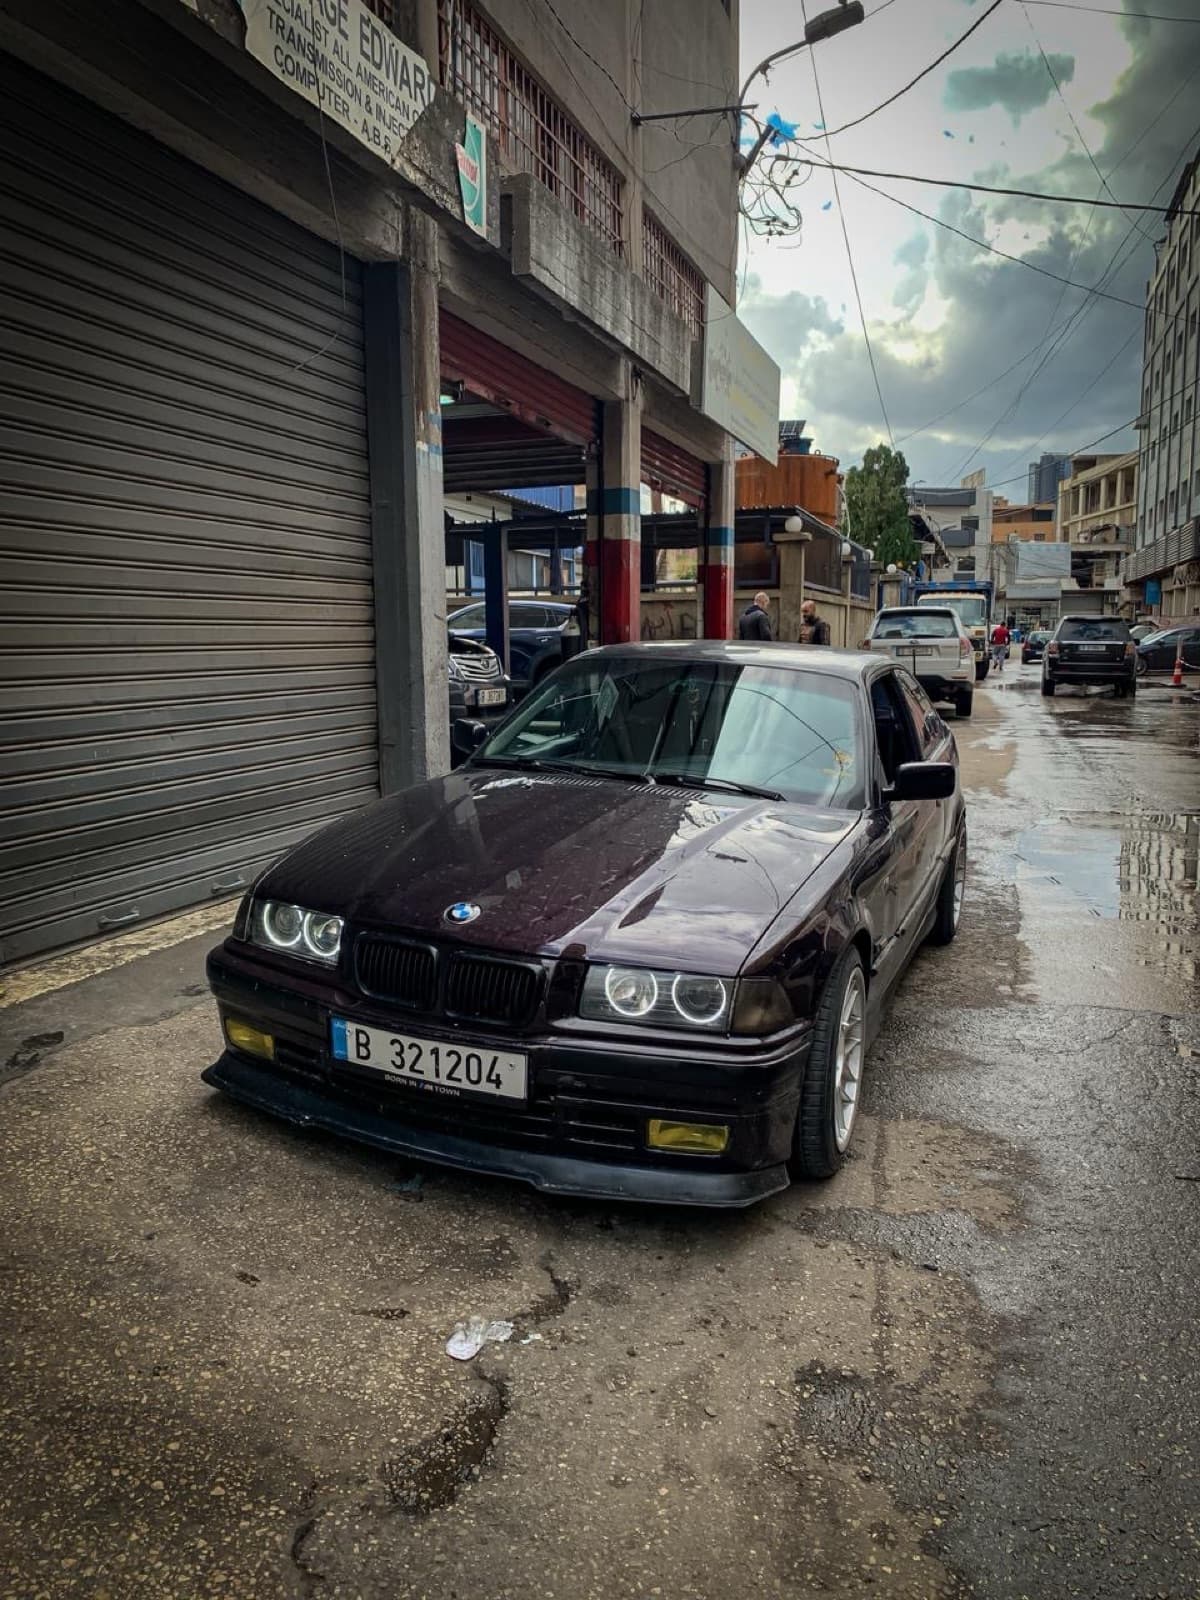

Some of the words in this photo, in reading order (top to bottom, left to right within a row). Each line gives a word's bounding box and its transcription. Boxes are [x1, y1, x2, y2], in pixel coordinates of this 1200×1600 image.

[267, 5, 361, 106] TRANSMISSION
[365, 95, 372, 115] &
[376, 103, 408, 139] INJEC
[274, 45, 350, 122] COMPUTER
[333, 39, 353, 72] ALL
[356, 62, 409, 121] AMERICAN
[355, 1028, 371, 1061] B
[389, 1038, 503, 1090] 321204
[384, 1074, 407, 1085] BORN
[408, 1079, 417, 1087] IN
[434, 1086, 461, 1097] TOWN
